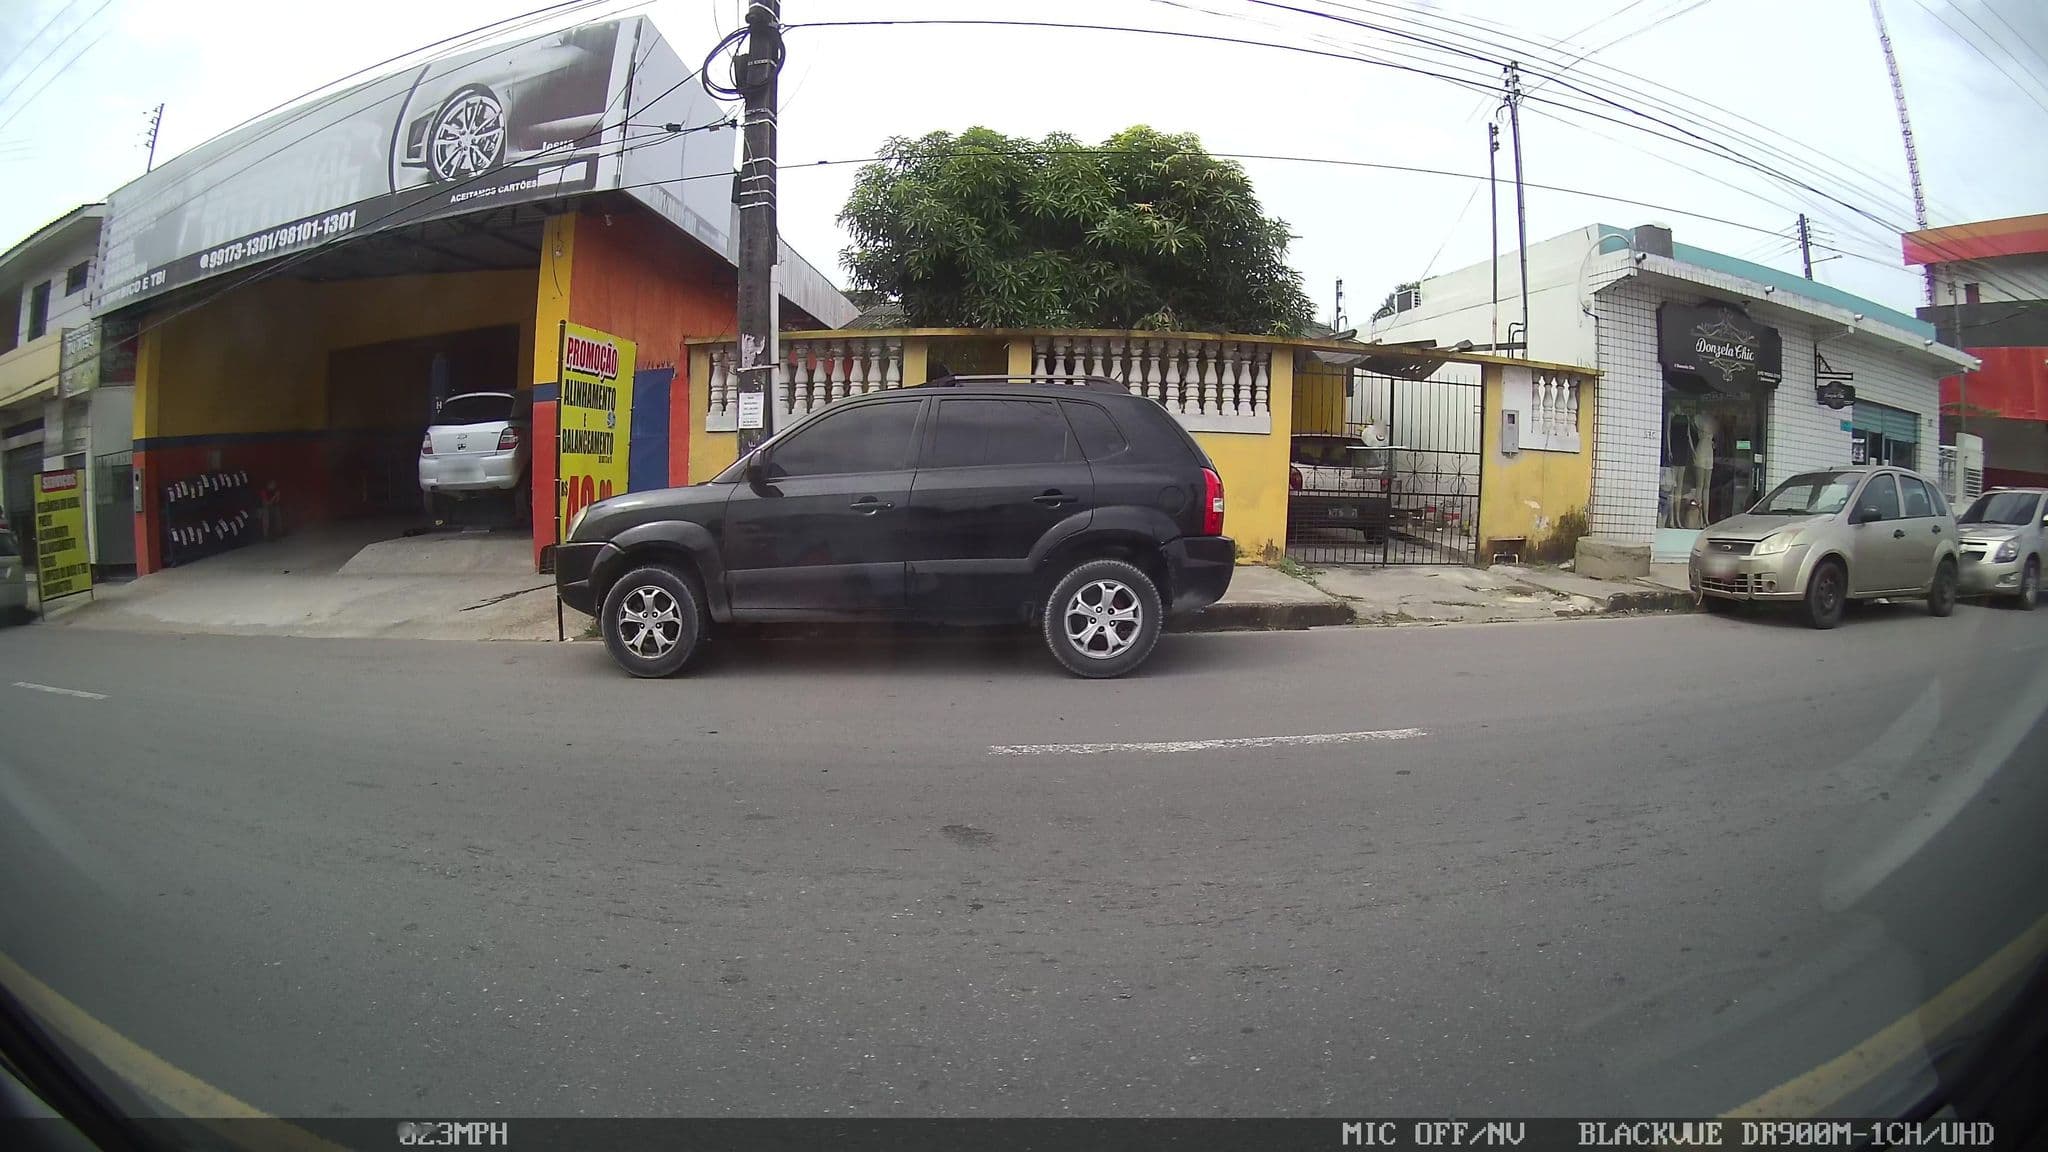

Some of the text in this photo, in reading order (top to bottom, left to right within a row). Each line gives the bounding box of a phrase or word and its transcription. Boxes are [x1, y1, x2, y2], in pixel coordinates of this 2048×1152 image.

[498, 179, 537, 194] CARTÕES
[209, 209, 357, 268] 99173-1301/98101-1301
[142, 276, 150, 290] E
[151, 269, 167, 287] TBI
[566, 336, 618, 377] PROMOÇÃO
[1695, 337, 1755, 361] Donzela Chic
[564, 379, 617, 412] ALINHAMENTO
[562, 428, 614, 455] BALANCEAMENTO
